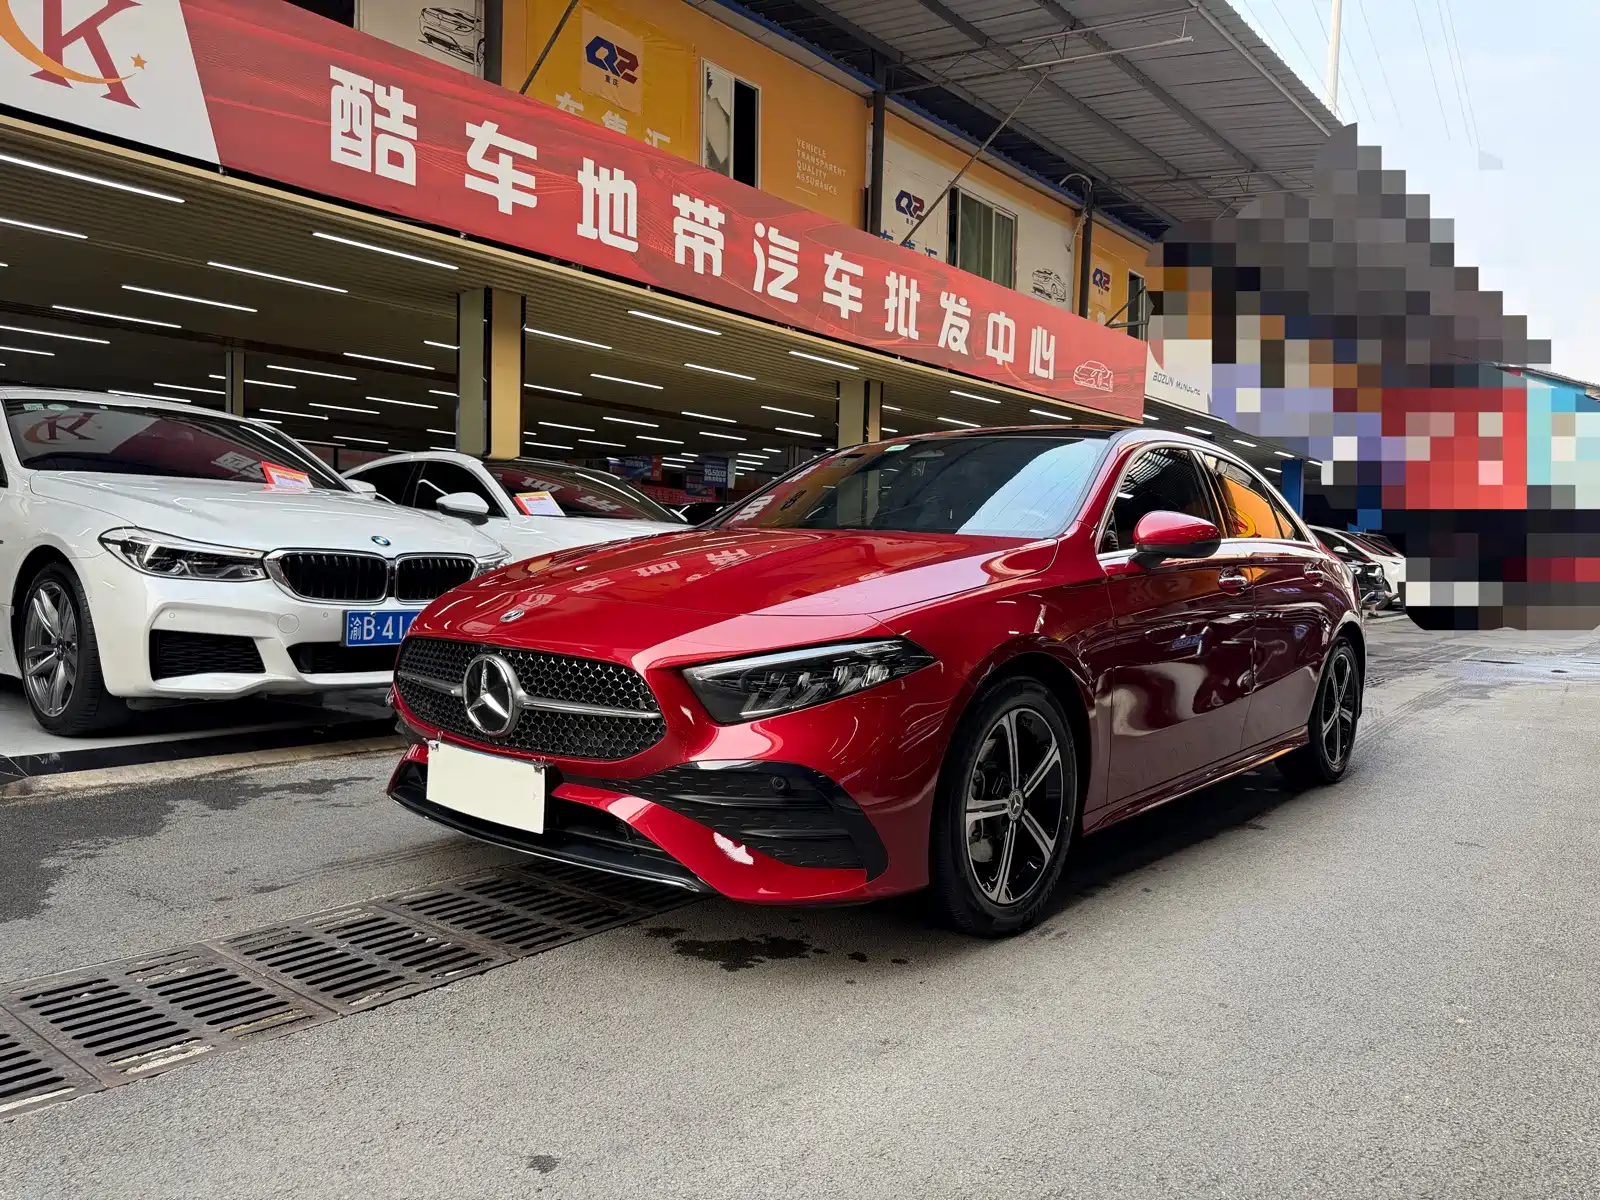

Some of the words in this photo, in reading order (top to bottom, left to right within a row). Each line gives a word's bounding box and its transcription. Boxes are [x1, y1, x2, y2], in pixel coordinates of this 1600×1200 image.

[796, 149, 847, 178] TRANSPARENT
[796, 160, 828, 181] QUALITY
[796, 171, 838, 196] ASSURANCE
[329, 65, 1056, 381] 酷车地带汽车批发中心
